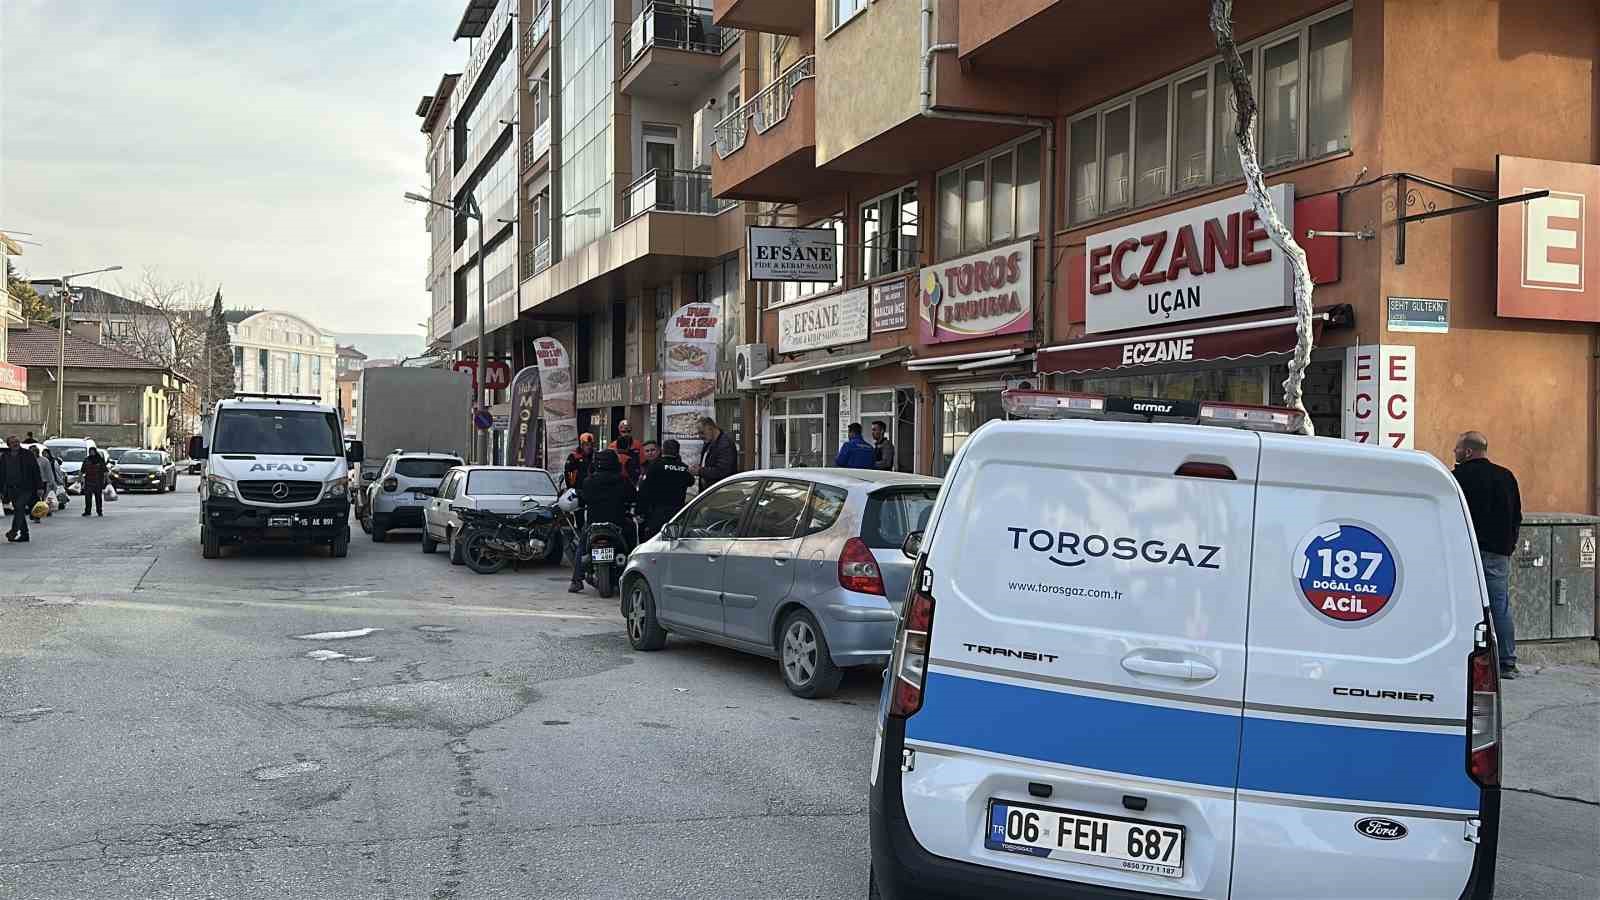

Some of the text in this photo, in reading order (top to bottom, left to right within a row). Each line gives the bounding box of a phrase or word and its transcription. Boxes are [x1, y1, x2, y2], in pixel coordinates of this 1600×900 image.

[1527, 197, 1580, 284] E
[757, 245, 832, 262] EFSANE
[1090, 208, 1272, 295] ECZANE
[944, 250, 1021, 298] TOROS
[1148, 286, 1201, 318] UÇAN
[794, 303, 839, 334] EFSANE
[1122, 339, 1195, 364] ECZANE
[1133, 403, 1172, 413] armas
[249, 463, 308, 472] AFAD
[1008, 526, 1221, 569] TOROSGAZ
[1317, 548, 1383, 580] 187
[1008, 580, 1123, 600] www.torosgaz.com.tr
[1313, 580, 1378, 594] DOĞAL GAZ
[1322, 595, 1368, 614] ACİL
[963, 643, 1059, 663] TRANSIT
[1333, 687, 1435, 702] COURIER
[992, 824, 1005, 834] TR
[1007, 810, 1179, 862] 06 FEH 687
[1366, 820, 1399, 837] Ford
